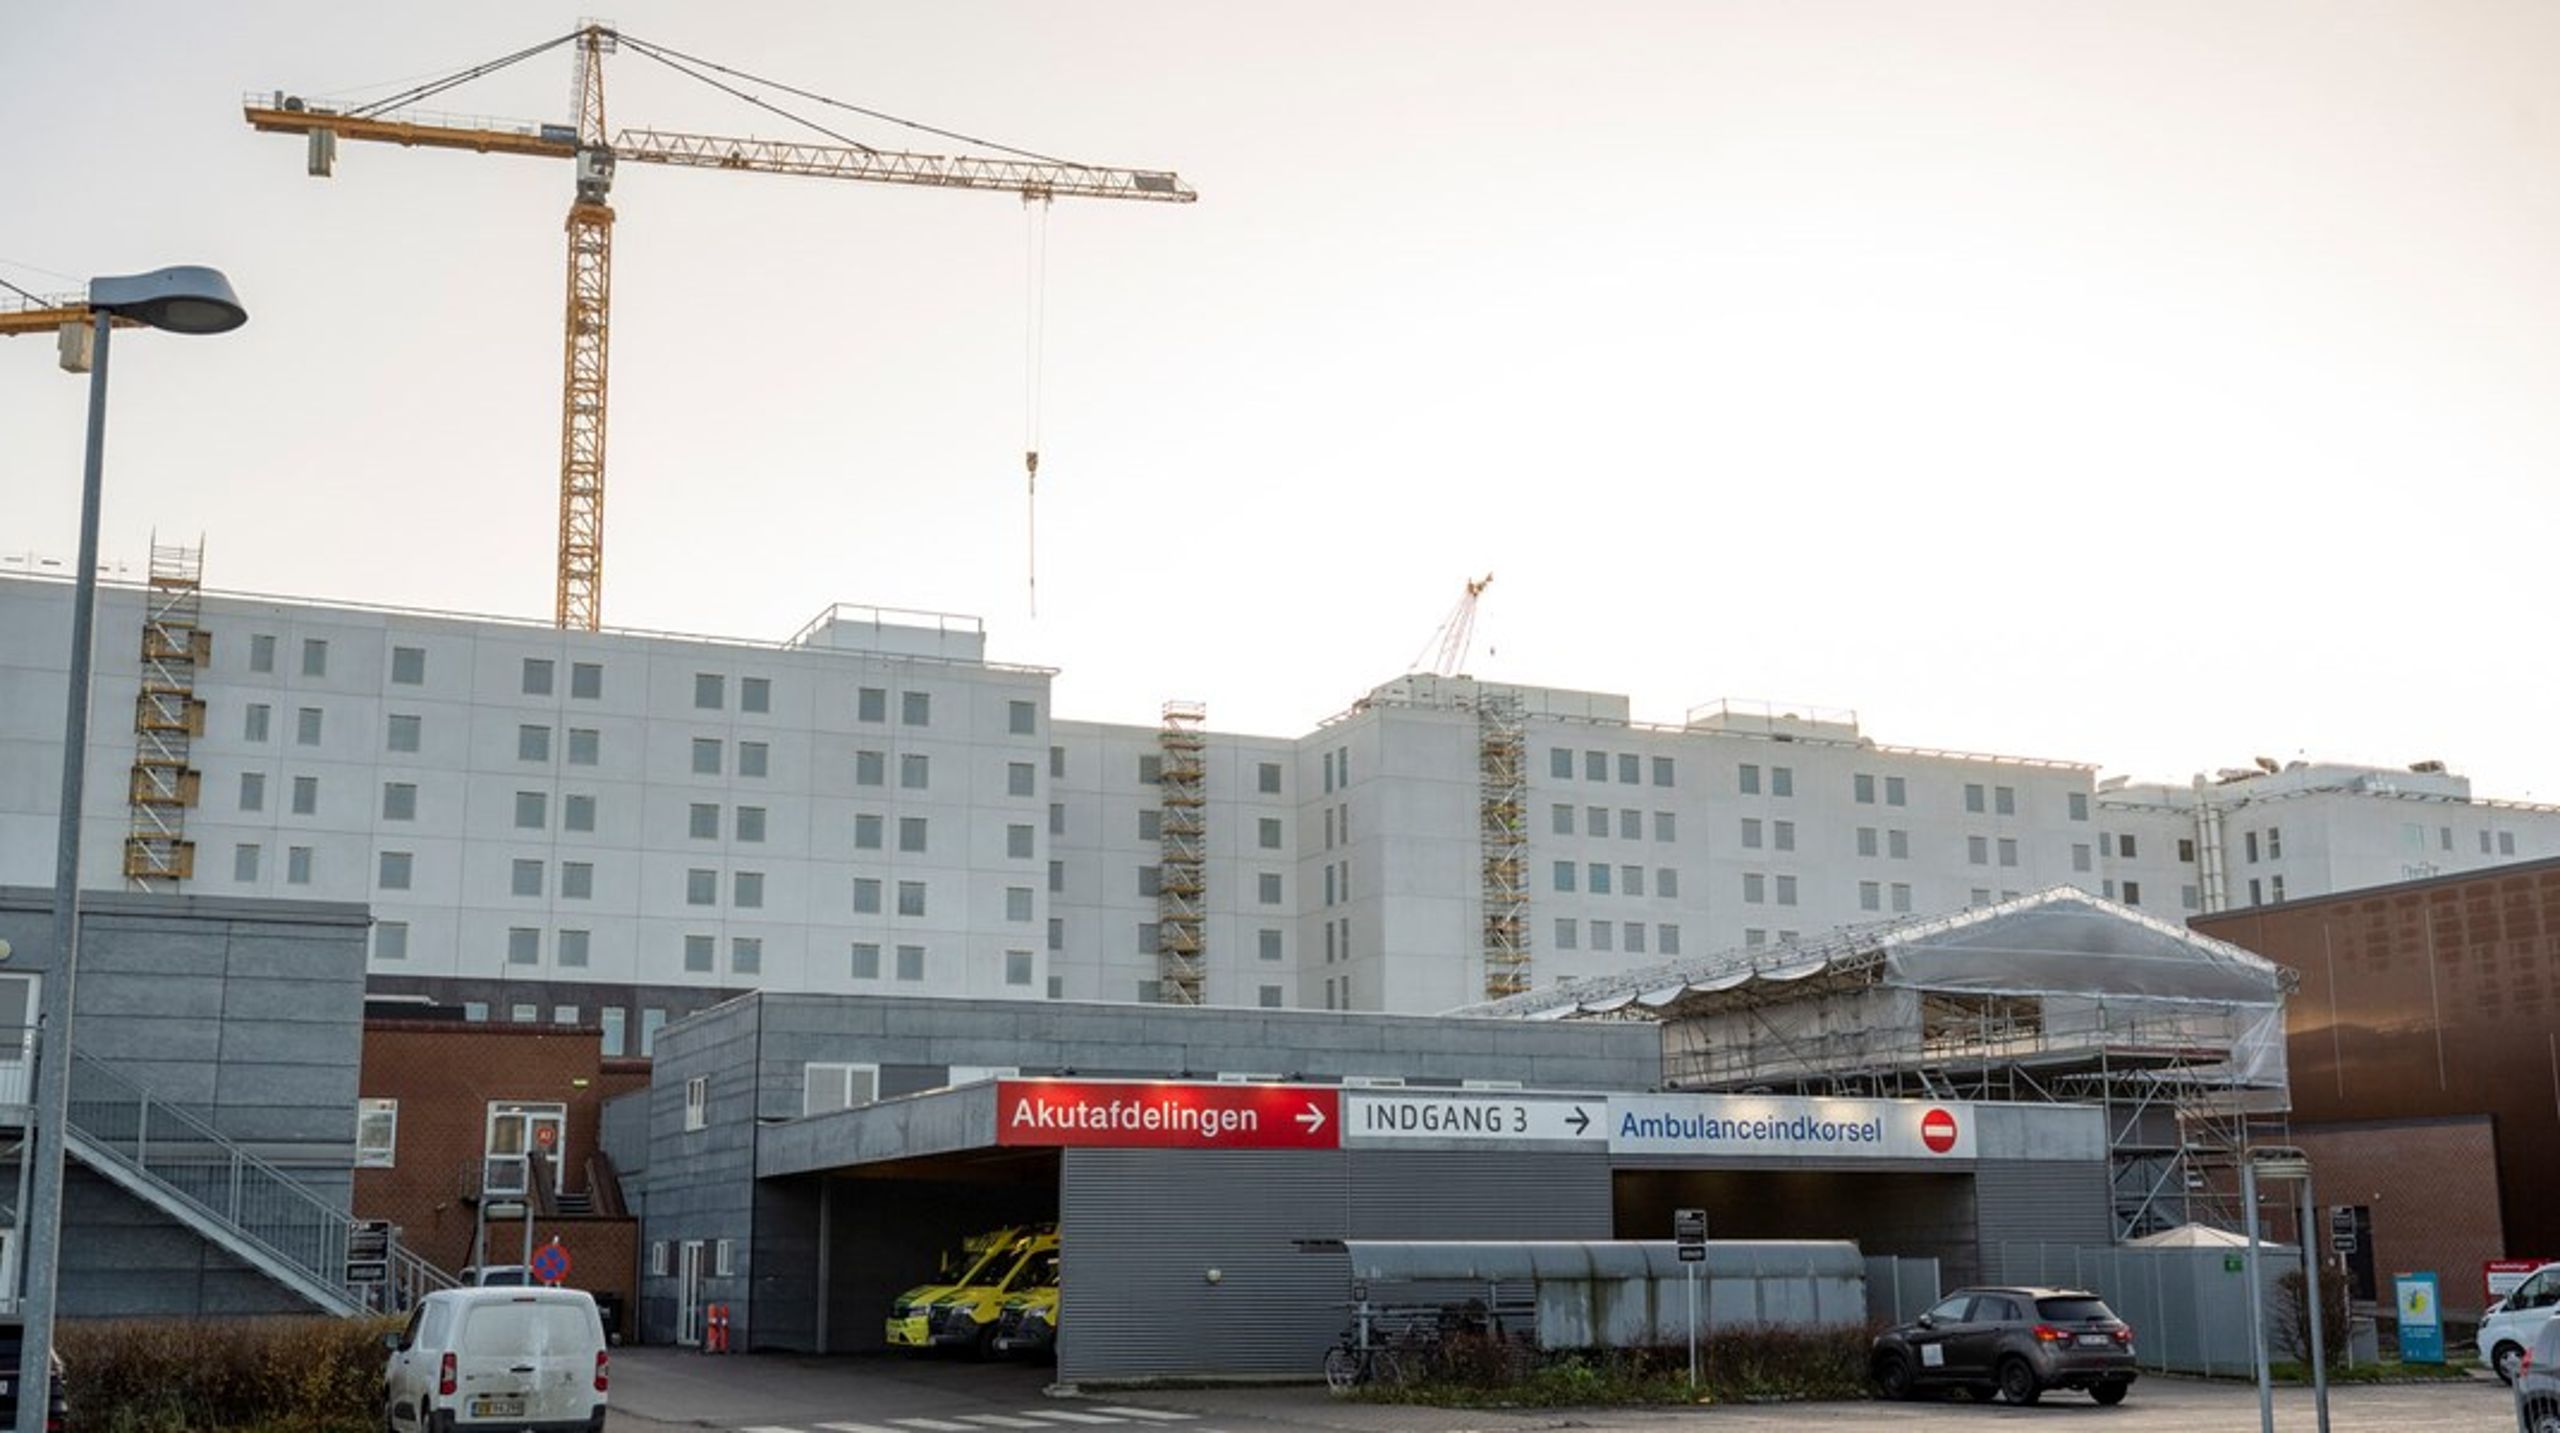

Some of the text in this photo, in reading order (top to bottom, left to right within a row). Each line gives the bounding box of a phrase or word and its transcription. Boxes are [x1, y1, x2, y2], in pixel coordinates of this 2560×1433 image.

[1012, 1098, 1258, 1138] Akutafdelingen
[1366, 1104, 1528, 1133] INDGANG 3
[1620, 1112, 1882, 1142] Ambulanceindkørsel
